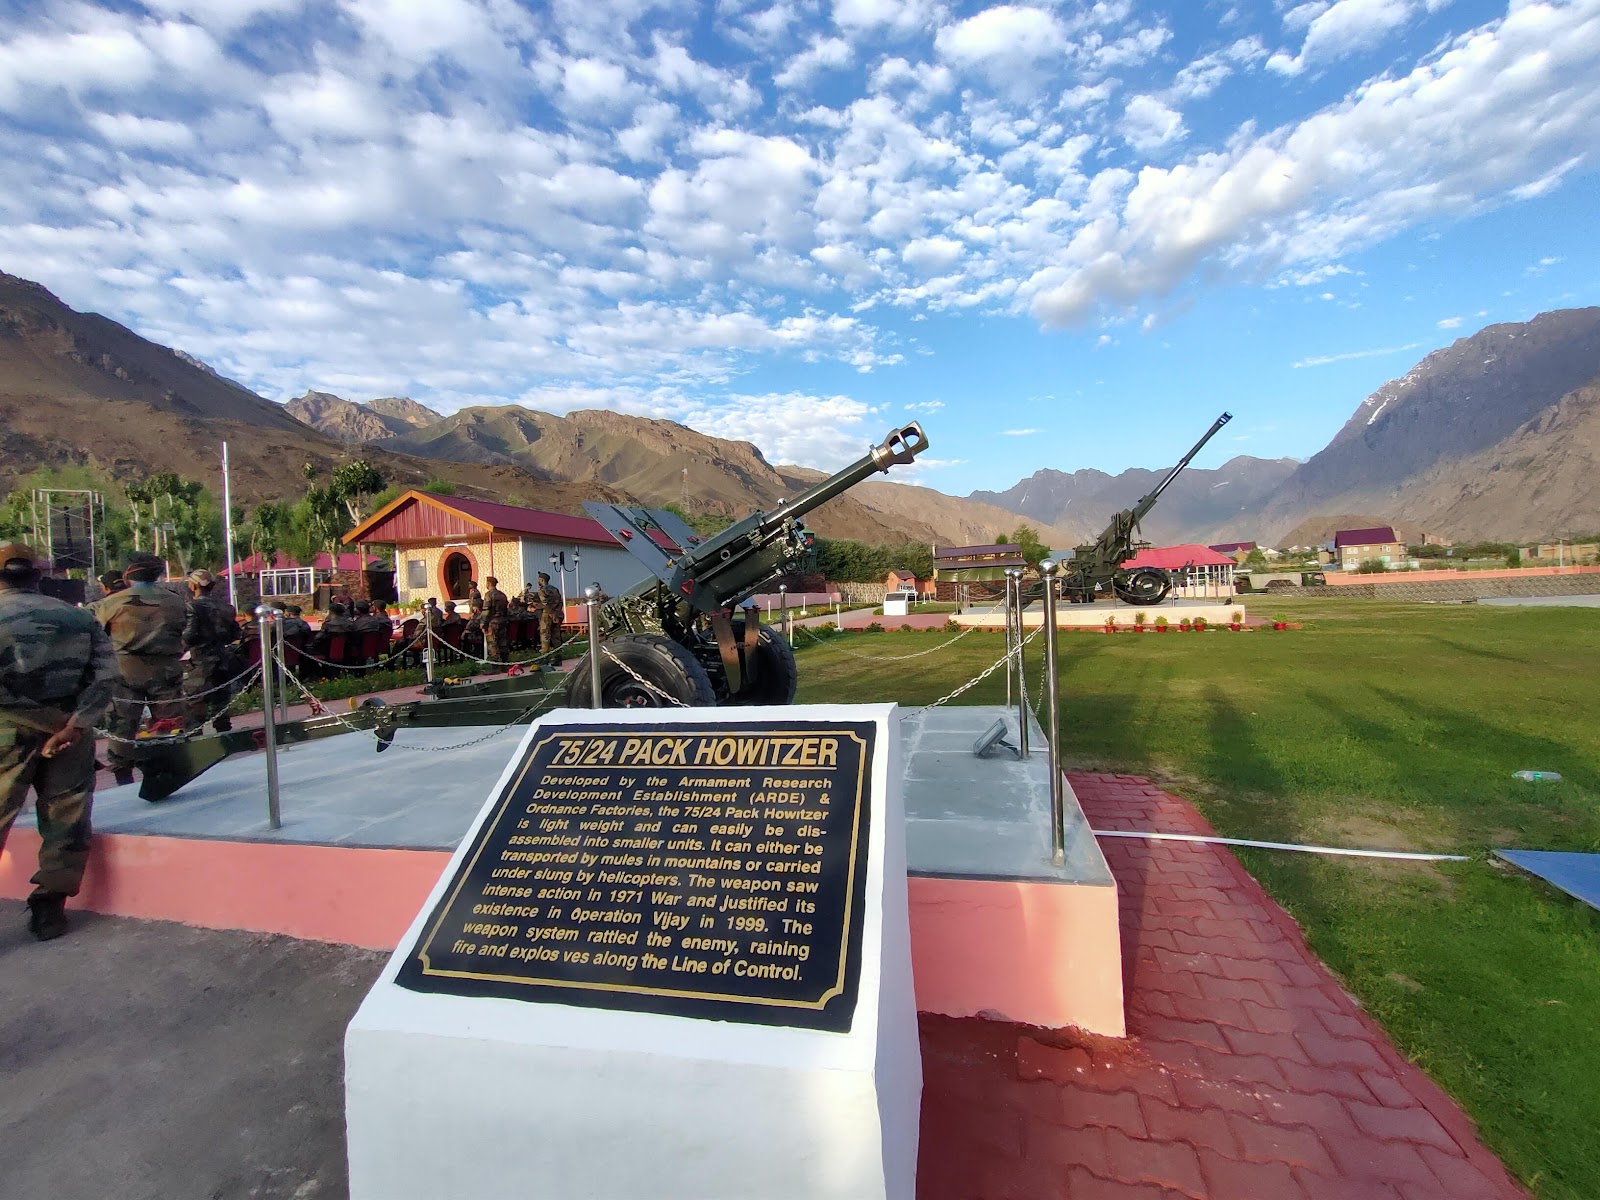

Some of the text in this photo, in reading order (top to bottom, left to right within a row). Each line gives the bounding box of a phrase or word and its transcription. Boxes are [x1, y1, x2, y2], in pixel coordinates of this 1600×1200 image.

[551, 738, 838, 766] 75/24 PACK HOWITZER
[540, 776, 832, 788] Developed by the Armament Research
[533, 789, 830, 806] Development Establishment (ARDE) &
[526, 803, 829, 820] Ordnance Factories, the 75/24 Pack Howitzer
[517, 818, 826, 838] is light weight and can easily be dis-
[509, 835, 823, 855] assembled into smaller units. It can either be
[501, 850, 821, 873] transported by mules in mountains or carried
[492, 867, 819, 893] under slung by helicopters. The weapon saw
[482, 883, 532, 897] intense
[537, 887, 581, 900] action
[587, 888, 601, 901] in
[611, 890, 643, 903] 1971
[652, 892, 682, 905] War
[687, 895, 717, 908] and
[796, 899, 815, 913] its
[473, 902, 539, 917] existence
[547, 906, 561, 918] in
[654, 911, 690, 930] Vijay
[700, 914, 714, 928] in
[727, 916, 768, 932] 1999.
[782, 919, 812, 935] The
[463, 923, 809, 961] weapon system rattled the enemy, raining
[452, 939, 476, 954] fire
[478, 944, 509, 957] and
[593, 951, 638, 971] along
[641, 953, 667, 969] the
[672, 956, 707, 973] Line
[712, 959, 731, 974] of
[734, 960, 802, 980] Control.
